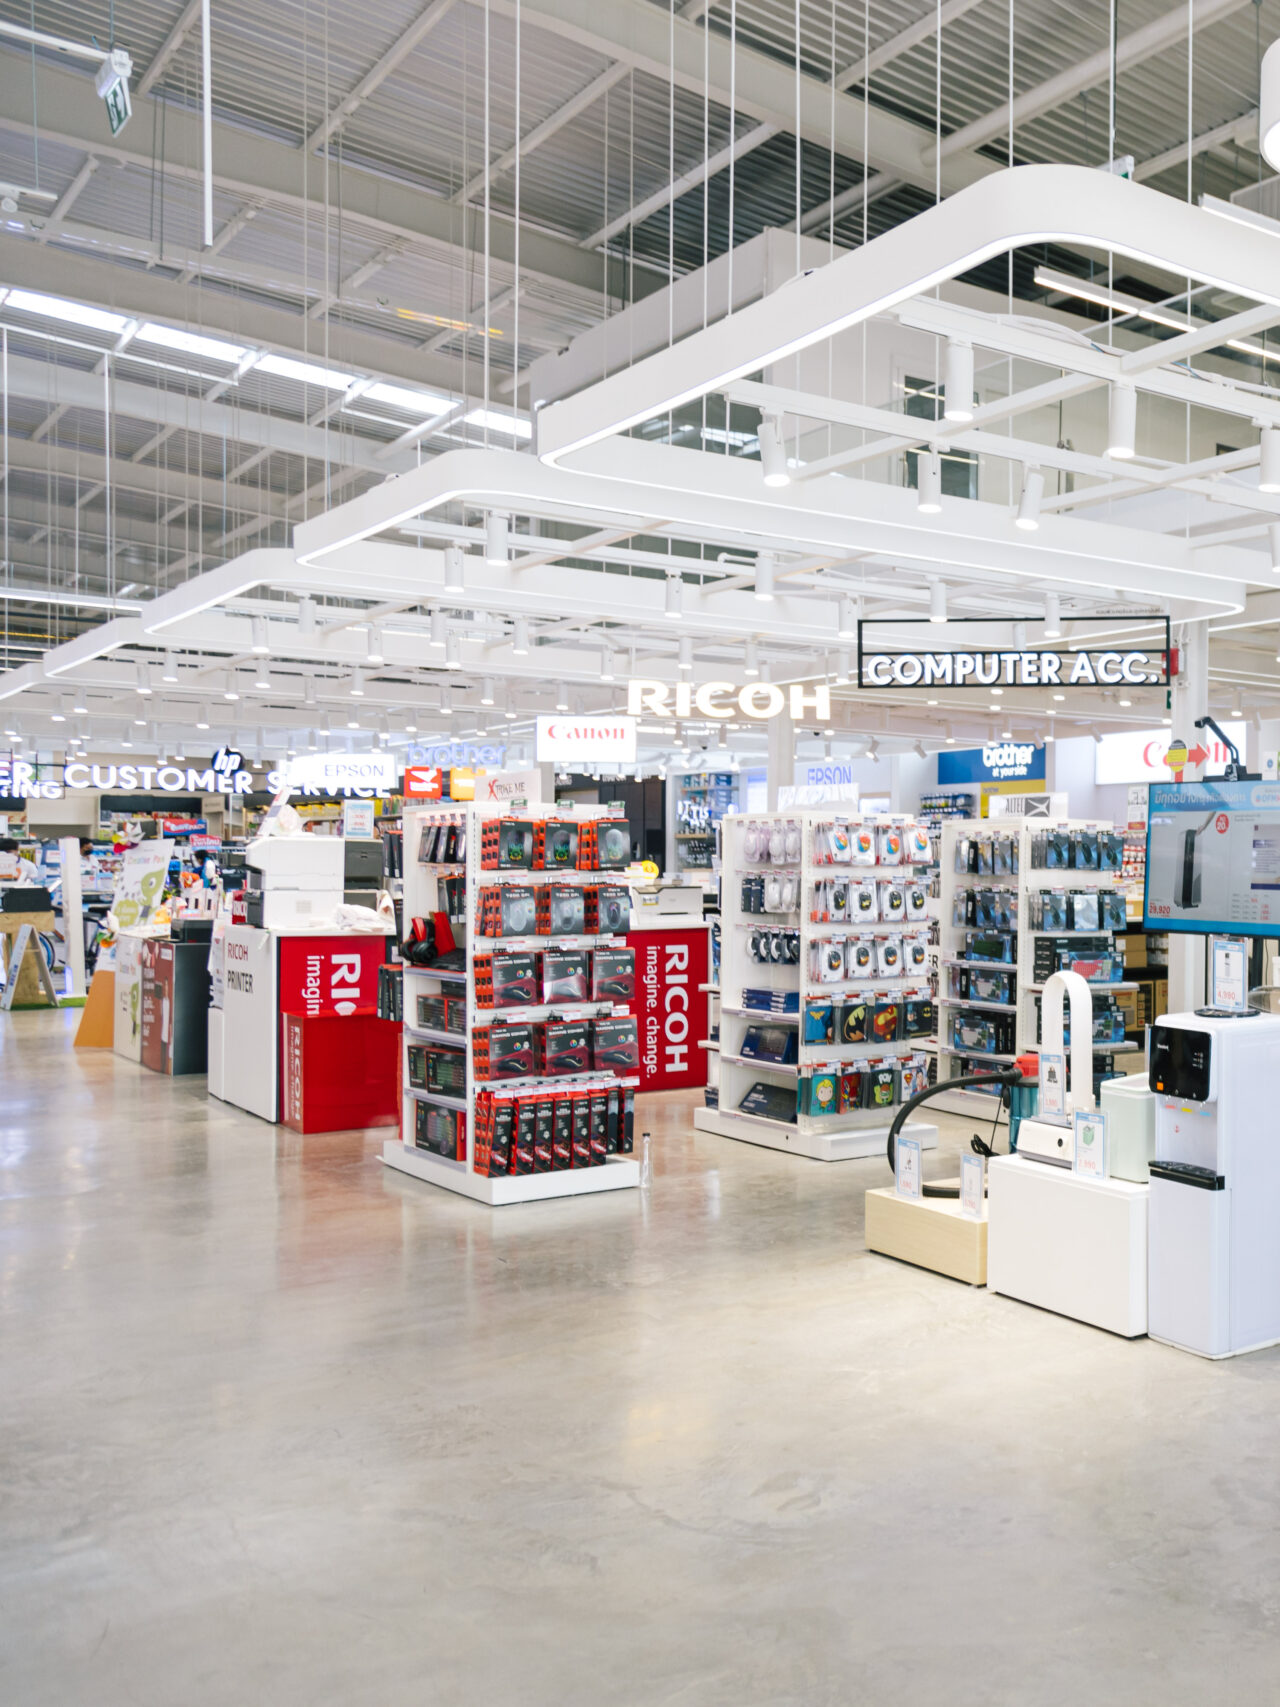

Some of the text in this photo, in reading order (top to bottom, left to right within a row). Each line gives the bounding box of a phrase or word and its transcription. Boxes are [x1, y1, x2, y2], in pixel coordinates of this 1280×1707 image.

[866, 652, 1159, 685] COMPUTER ACC.
[627, 679, 831, 720] RICOH
[548, 725, 625, 740] Canon
[213, 748, 241, 778] hp
[408, 742, 507, 766] brother
[982, 744, 1035, 768] brother
[64, 763, 254, 794] CUSTOMER
[324, 764, 384, 777] EPSON
[227, 942, 249, 962] RICOH
[227, 969, 254, 994] PRINTER
[643, 946, 660, 1079] imagine. change.
[665, 944, 689, 1073] RICOH
